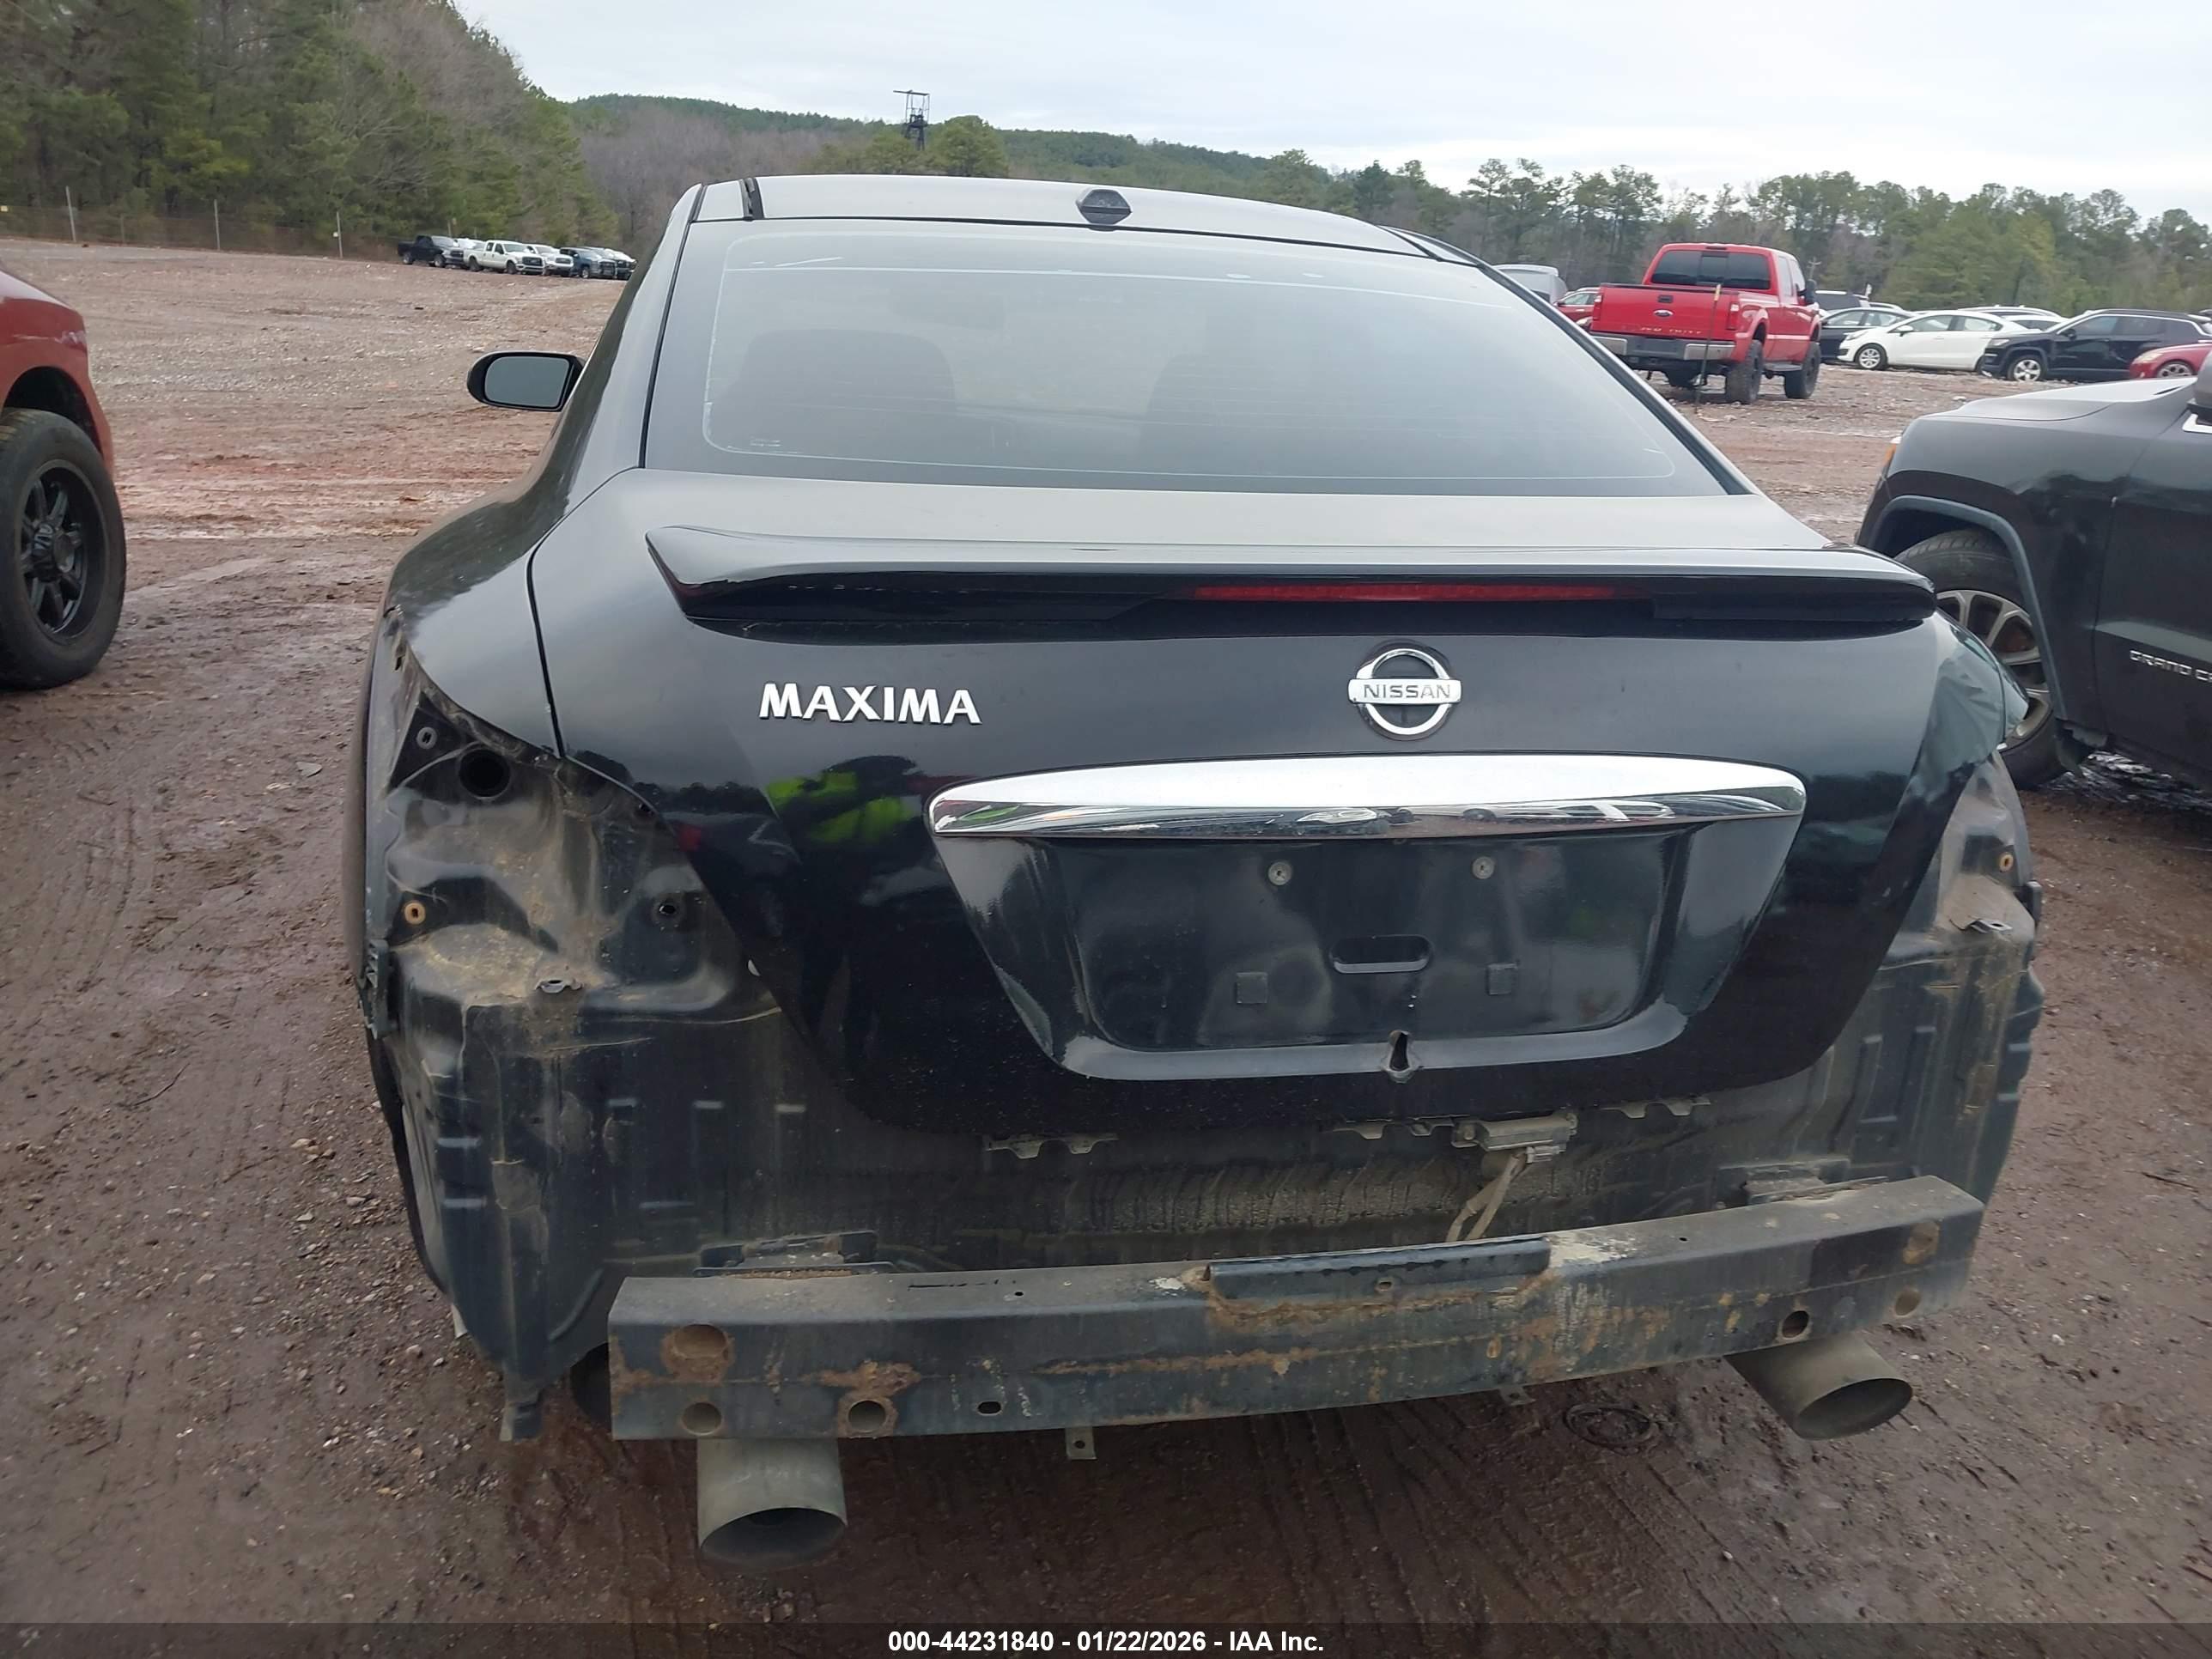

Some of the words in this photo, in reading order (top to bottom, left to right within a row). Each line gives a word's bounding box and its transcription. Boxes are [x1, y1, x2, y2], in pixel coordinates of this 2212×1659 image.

[2130, 649, 2192, 676] GRAND
[759, 683, 982, 725] MAXIMA
[1363, 684, 1451, 700] NISSAN
